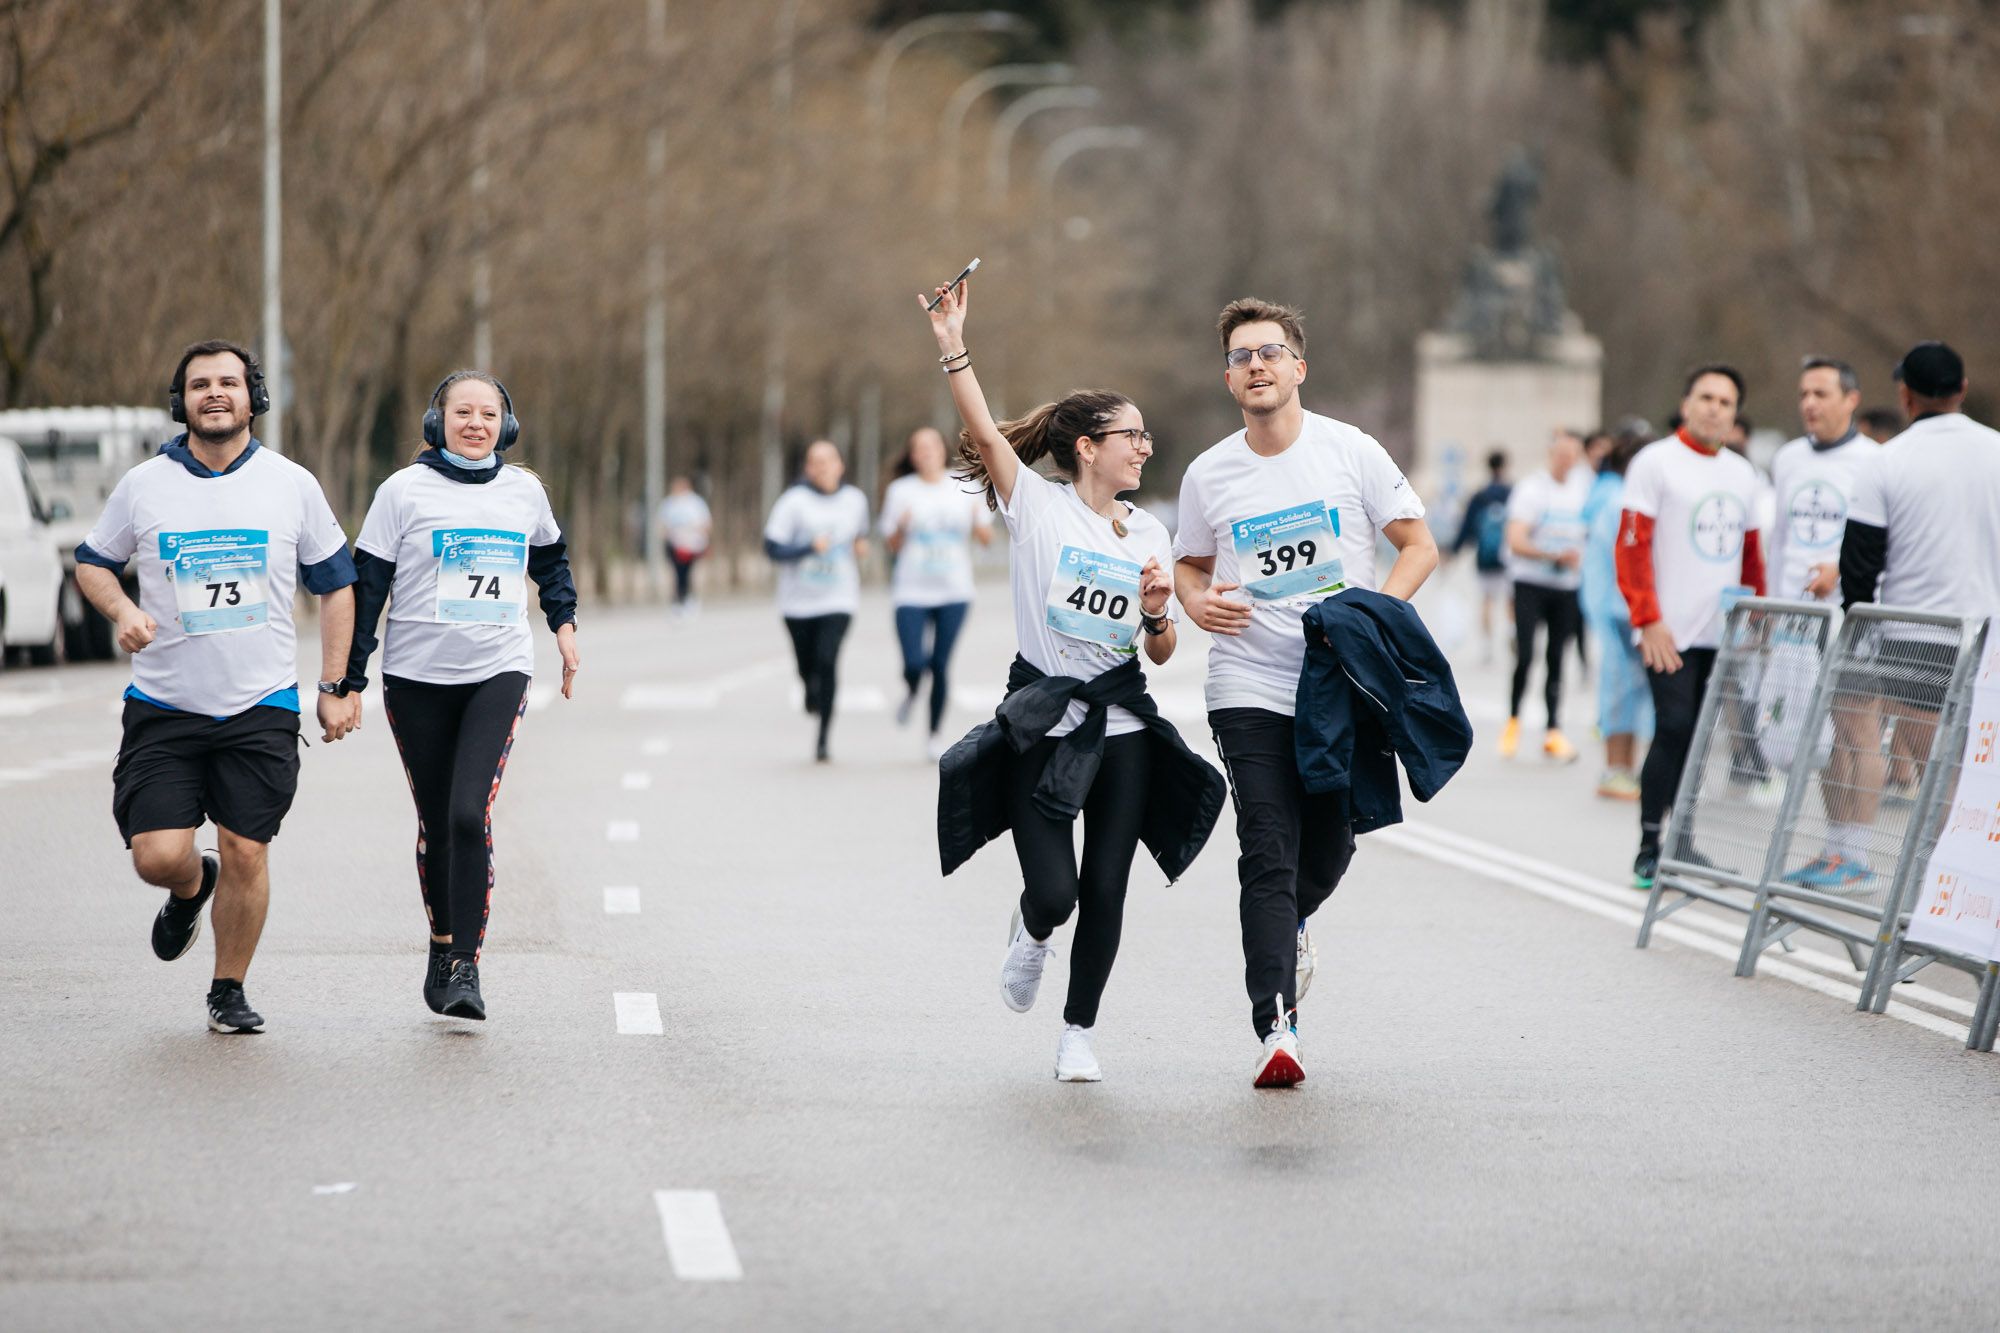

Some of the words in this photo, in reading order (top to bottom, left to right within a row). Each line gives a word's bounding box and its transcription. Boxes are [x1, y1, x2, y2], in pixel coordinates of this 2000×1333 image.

[1249, 520, 1278, 531] Carrera
[1279, 511, 1312, 524] Solidaria
[1257, 540, 1317, 576] 399
[206, 581, 241, 608] 73
[468, 575, 501, 600] 74
[1066, 585, 1129, 620] 400
